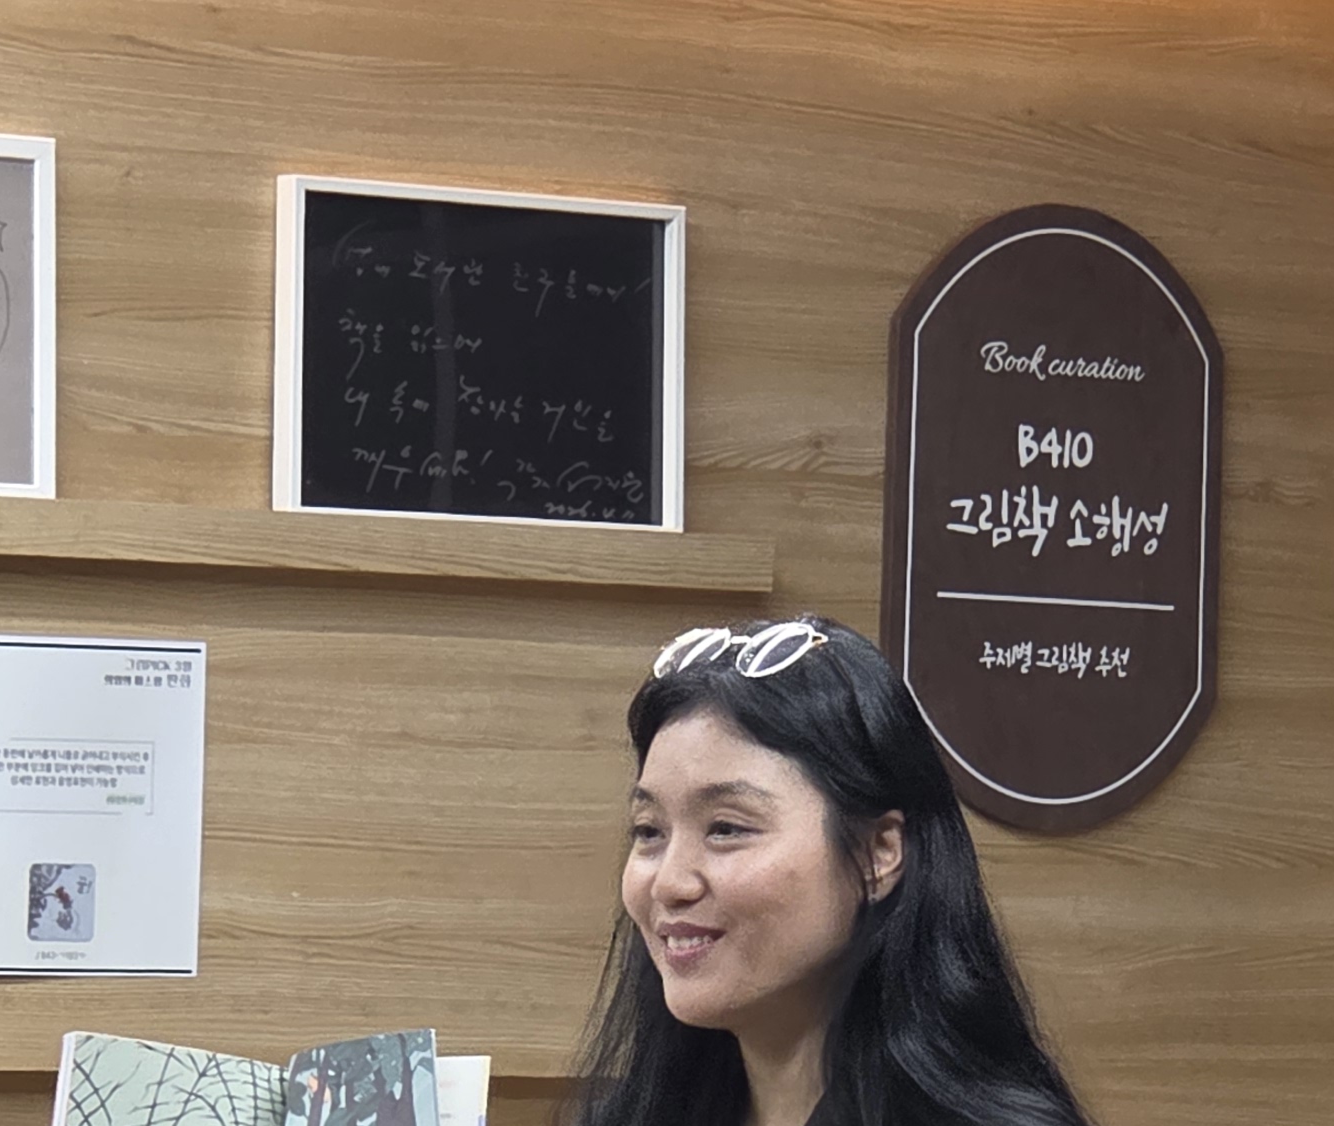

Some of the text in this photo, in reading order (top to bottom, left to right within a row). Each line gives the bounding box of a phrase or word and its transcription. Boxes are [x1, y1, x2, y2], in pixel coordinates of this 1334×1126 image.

[980, 341, 1145, 384] Book curation
[1017, 423, 1094, 469] B410
[946, 484, 1169, 557] 그림책 소행성
[979, 641, 1131, 679] 주제별 그림책 추천
